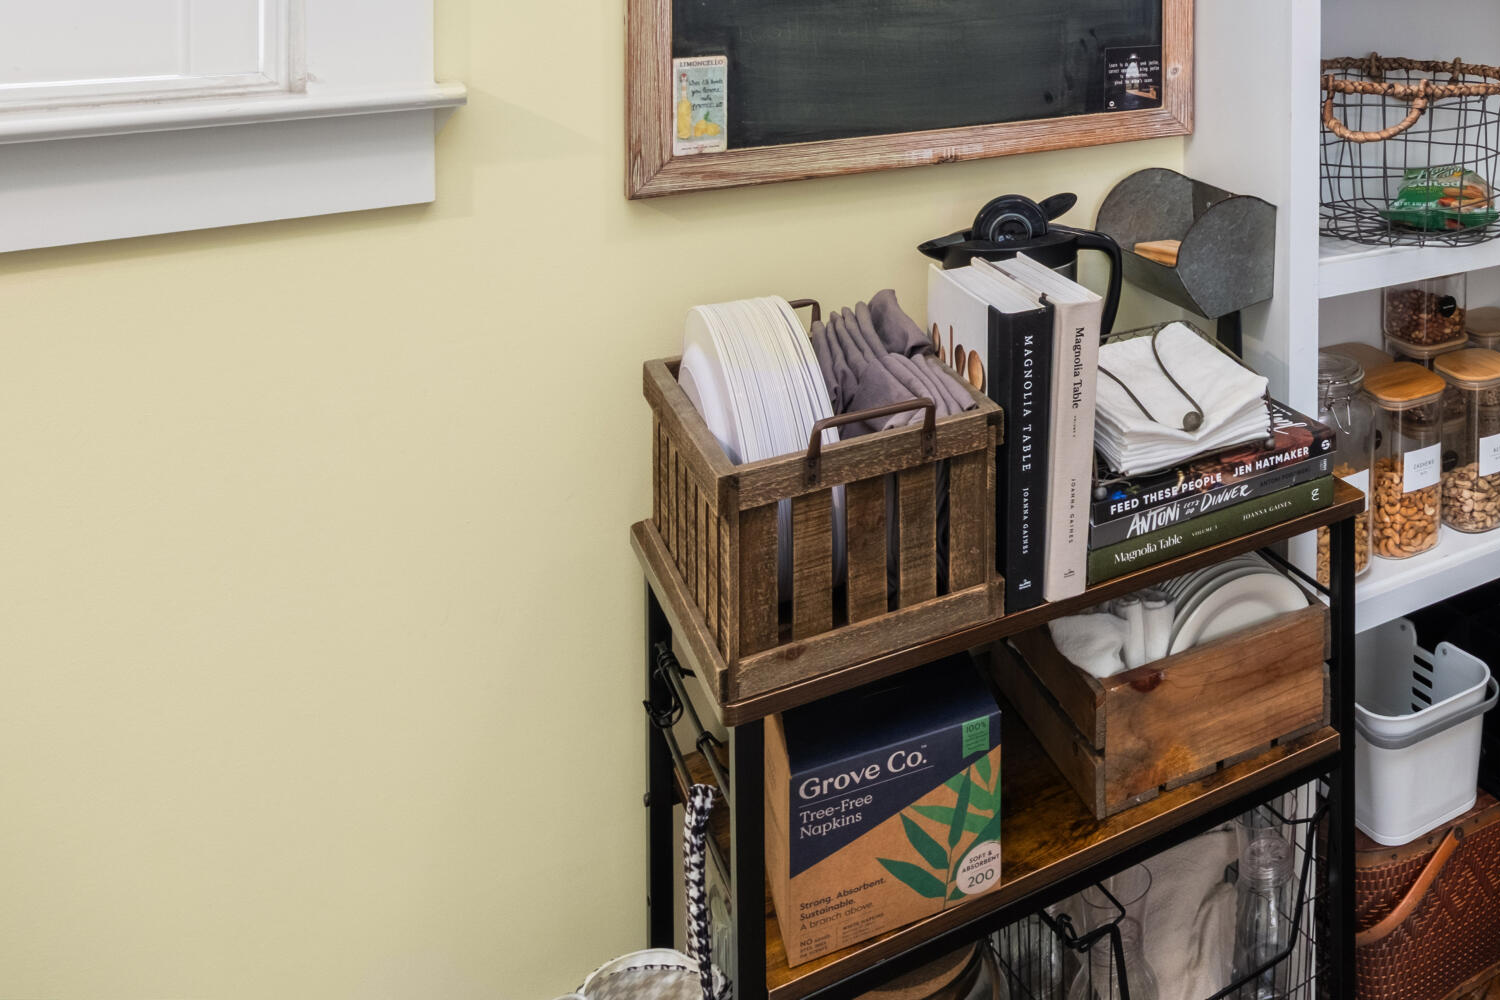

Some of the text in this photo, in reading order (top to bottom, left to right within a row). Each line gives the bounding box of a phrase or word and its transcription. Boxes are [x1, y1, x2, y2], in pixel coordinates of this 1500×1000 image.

[680, 59, 724, 68] LIMONCELLO
[1072, 327, 1085, 409] Magnolia Table
[1022, 335, 1034, 472] MAGNOLIA TABLE
[1110, 498, 1139, 515] FEED
[1142, 487, 1179, 505] THESE
[1181, 472, 1222, 494] PEOPLE
[1232, 463, 1252, 478] JEN
[1255, 446, 1310, 471] HATMAKER
[1022, 487, 1030, 521] JOANNA
[1200, 484, 1255, 513] DINNER
[1114, 543, 1157, 564] Magnolia
[1159, 533, 1183, 551] Table
[1242, 508, 1268, 521] JOANNA
[1268, 500, 1293, 512] GAINES
[966, 720, 987, 734] 100%
[799, 764, 880, 799] Grove
[800, 794, 873, 824] Tree-Free
[800, 812, 862, 839] Napkins
[962, 853, 1000, 873] ABSORBENT
[969, 852, 987, 864] SOFT
[968, 868, 995, 889] 200
[800, 899, 856, 921] Sustainable.
[800, 923, 807, 931] A
[809, 912, 842, 929] branch
[800, 938, 814, 948] NO
